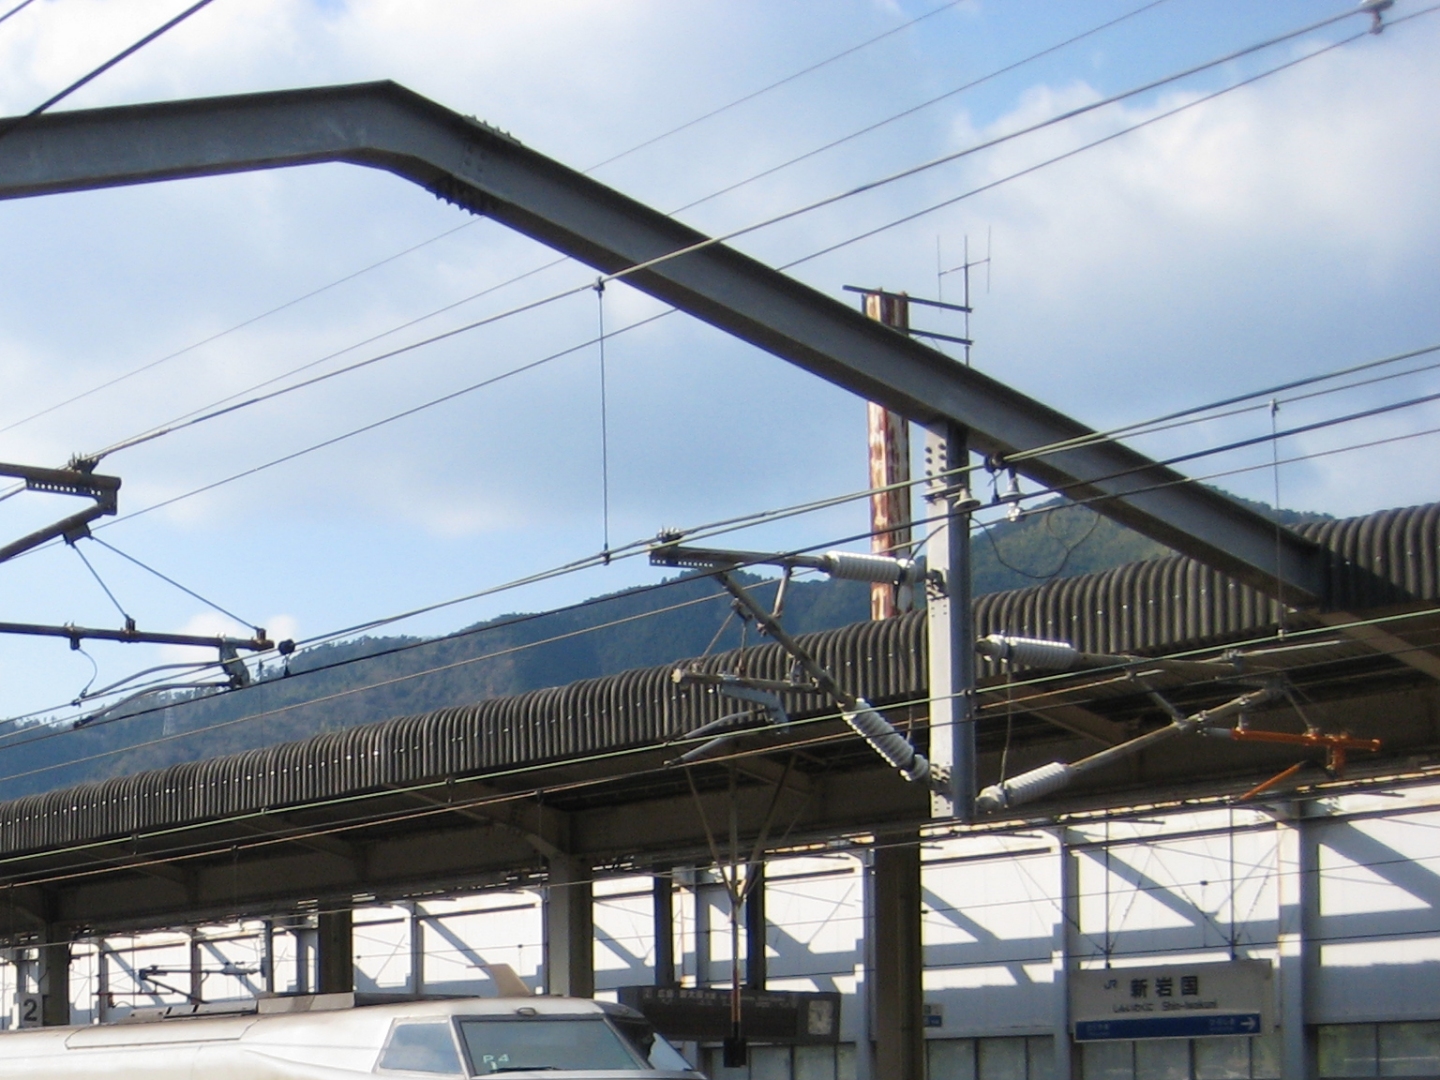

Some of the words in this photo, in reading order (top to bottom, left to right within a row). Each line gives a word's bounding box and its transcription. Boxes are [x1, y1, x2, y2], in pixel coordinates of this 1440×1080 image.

[1130, 975, 1199, 999] 新岩国
[23, 998, 37, 1022] 2
